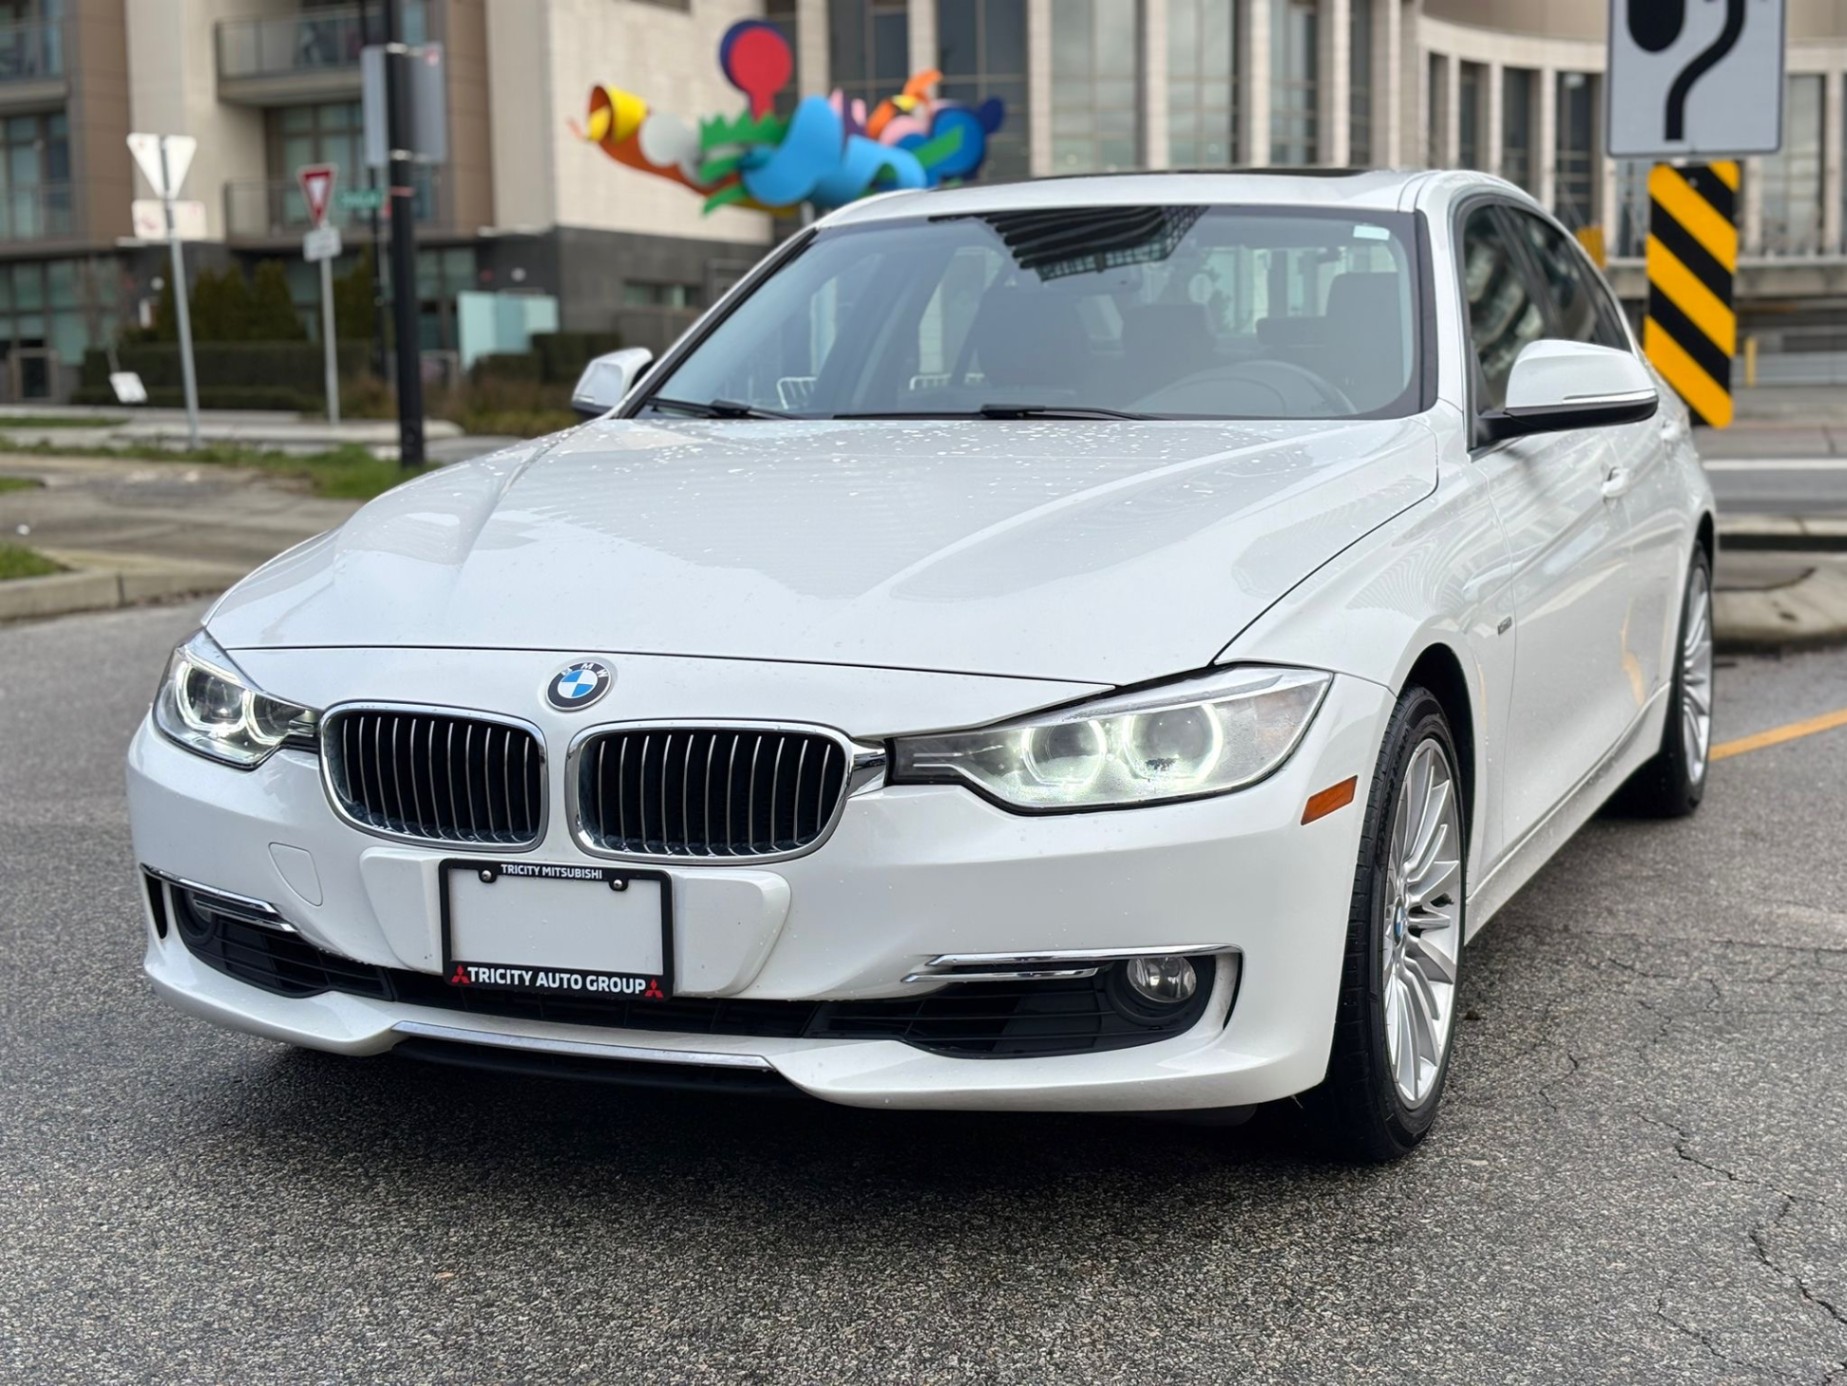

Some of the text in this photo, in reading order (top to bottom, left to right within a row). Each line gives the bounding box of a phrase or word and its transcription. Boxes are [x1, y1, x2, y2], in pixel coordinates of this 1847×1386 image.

[501, 864, 602, 879] TRICITY MITSUBISHI
[467, 967, 646, 994] TRICITY AUTO GROUP
